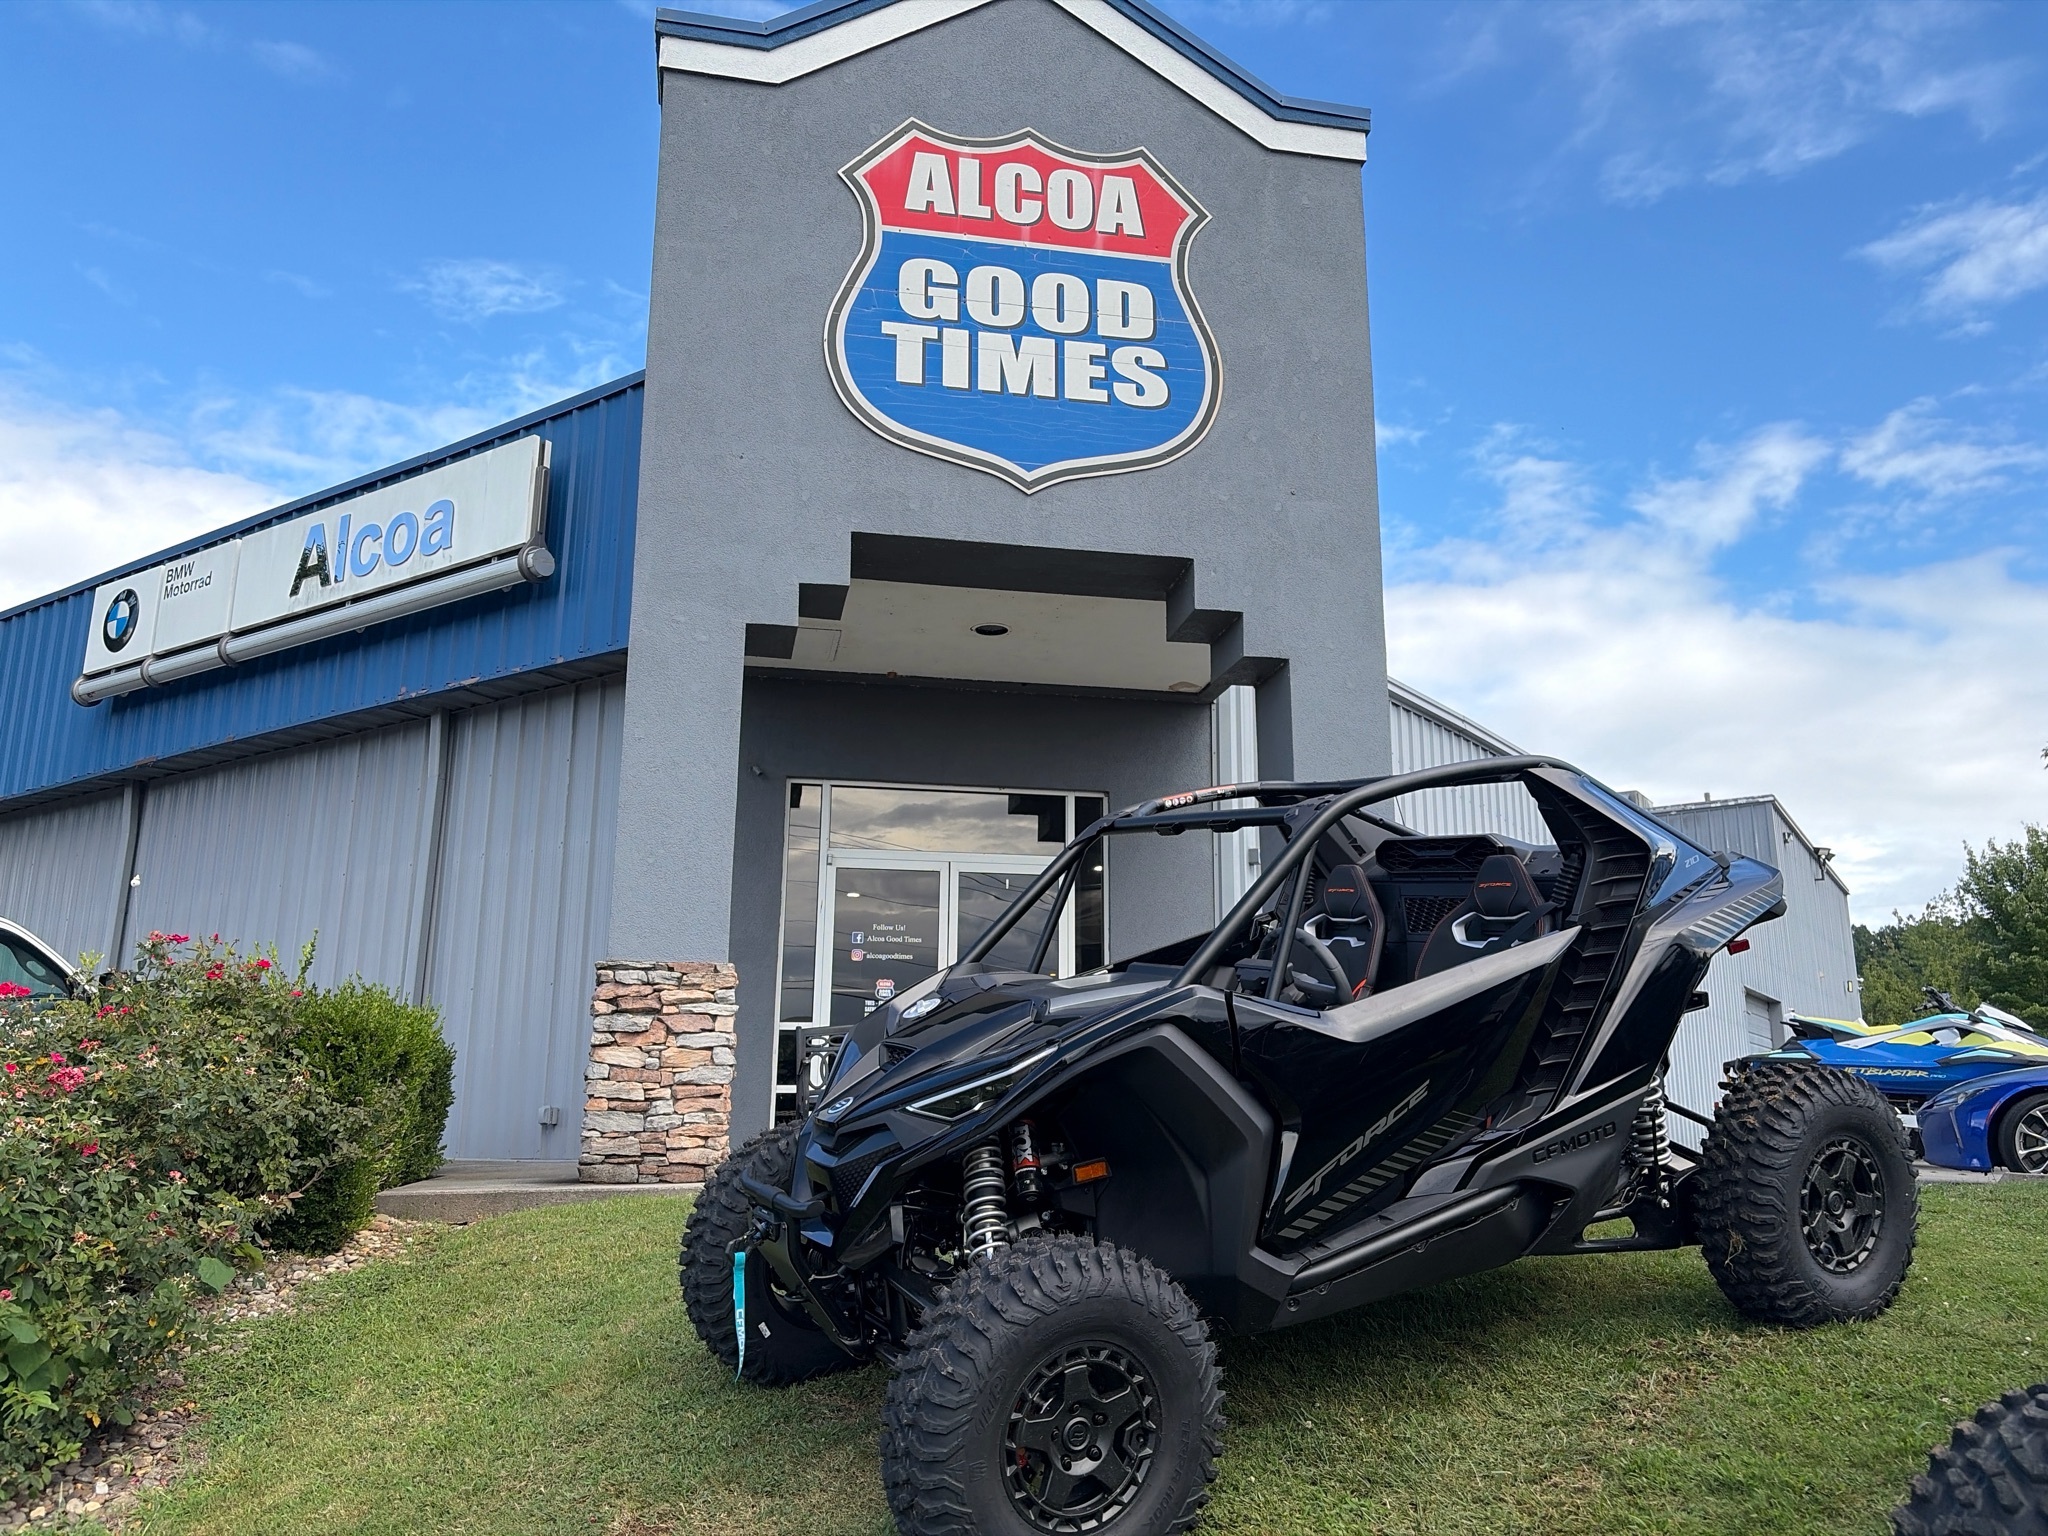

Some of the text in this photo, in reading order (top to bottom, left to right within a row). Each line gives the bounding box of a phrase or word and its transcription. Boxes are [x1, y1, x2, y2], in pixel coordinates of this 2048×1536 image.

[904, 151, 1146, 238] ALCOA
[898, 258, 1156, 341] GOOD
[881, 320, 1171, 410] TIMES
[289, 499, 455, 598] Alcoa
[163, 571, 213, 600] Motorrad
[165, 561, 195, 584] BMW
[1684, 855, 1700, 869] Z10
[872, 923, 894, 931] Follow
[886, 935, 903, 943] Good
[866, 952, 913, 960] alcoagoodtimes
[1013, 1124, 1034, 1165] FOX
[1285, 1079, 1431, 1215] ZFORCE
[1532, 1121, 1617, 1166] CFMOTO
